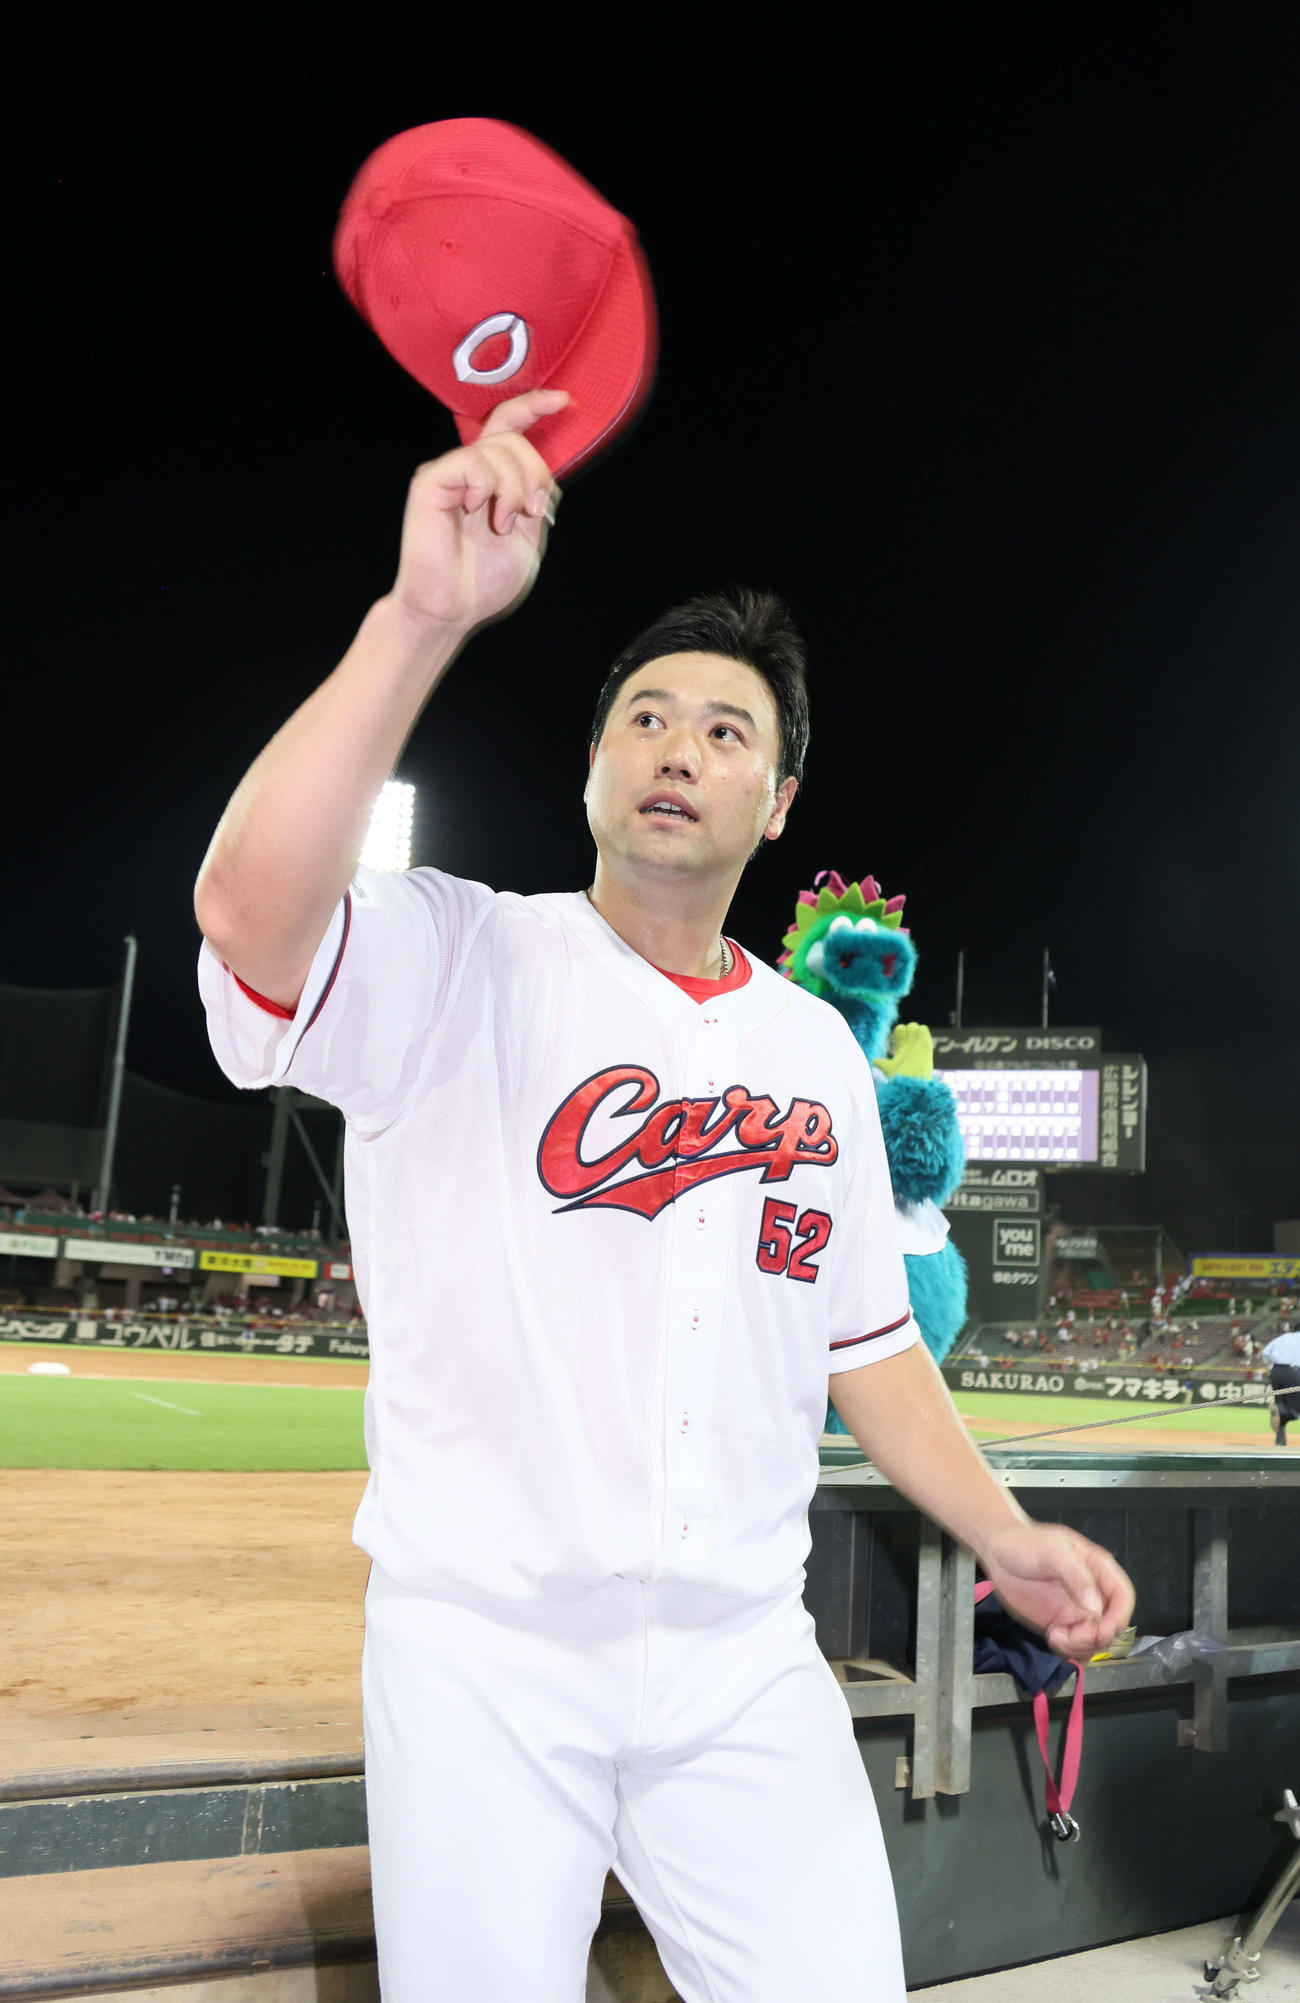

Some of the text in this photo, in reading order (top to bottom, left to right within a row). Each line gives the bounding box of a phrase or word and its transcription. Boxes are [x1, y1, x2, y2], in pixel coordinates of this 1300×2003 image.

[1025, 1036, 1095, 1050] DISCO
[537, 1064, 838, 1222] Carp
[991, 1169, 1038, 1187] ムロオ
[756, 1196, 833, 1283] 52
[1000, 1229, 1033, 1245] you
[1005, 1243, 1034, 1257] me
[100, 1323, 196, 1349] ユウベル
[961, 1371, 1064, 1392] SAKURAO
